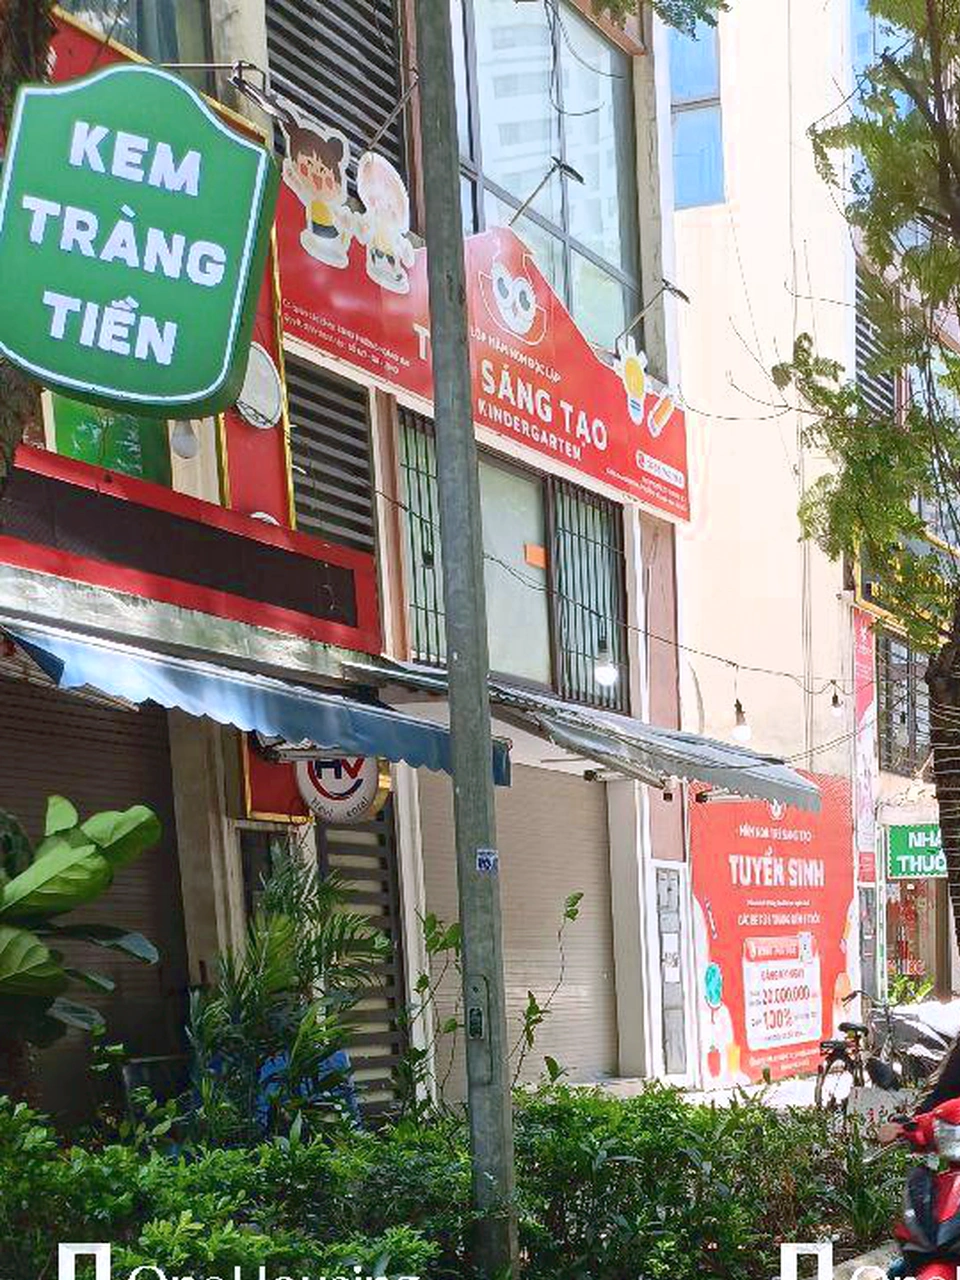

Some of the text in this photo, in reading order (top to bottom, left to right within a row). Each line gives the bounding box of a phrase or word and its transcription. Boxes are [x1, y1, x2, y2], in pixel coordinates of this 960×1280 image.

[69, 121, 201, 196] KEM
[23, 194, 226, 287] TRÀNG
[43, 291, 177, 366] TIỀN
[478, 398, 582, 461] KINDERGARTEN
[481, 359, 607, 451] SÁNG TẠO
[728, 846, 785, 887] TUYỂN
[788, 858, 825, 887] SINH
[896, 847, 947, 872] THUỐ
